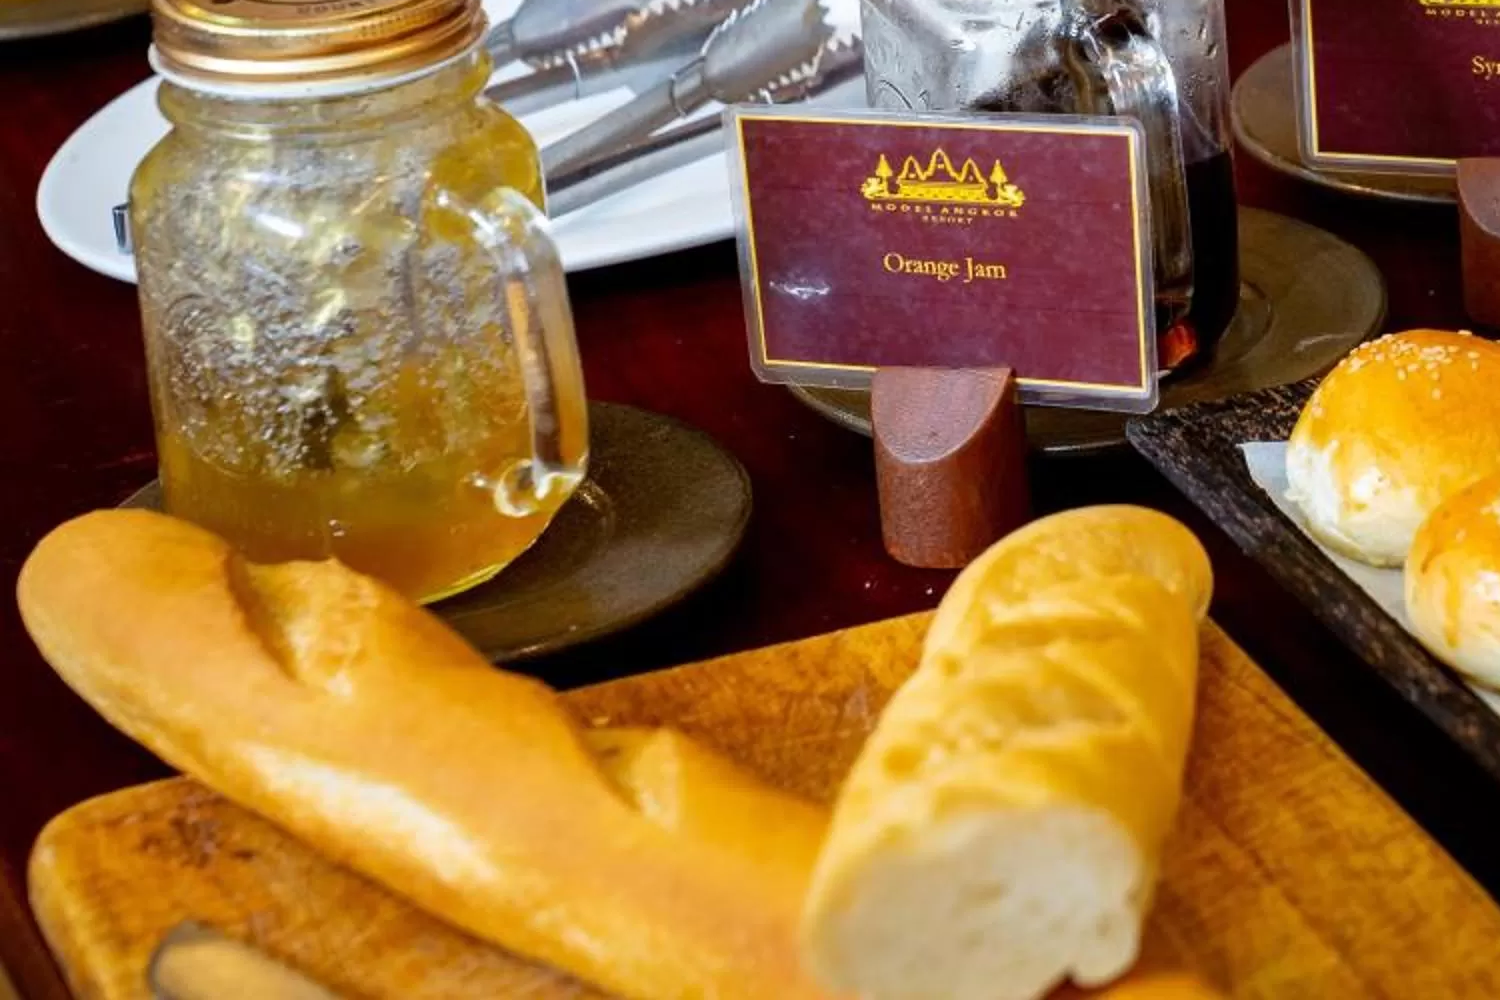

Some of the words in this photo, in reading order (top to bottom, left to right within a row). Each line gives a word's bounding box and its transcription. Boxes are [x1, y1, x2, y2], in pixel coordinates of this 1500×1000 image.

[1425, 9, 1486, 18] MODEL
[871, 203, 932, 214] MODEL
[940, 205, 1018, 217] ANGKOR
[883, 252, 960, 281] Orange
[963, 257, 1007, 283] Jam
